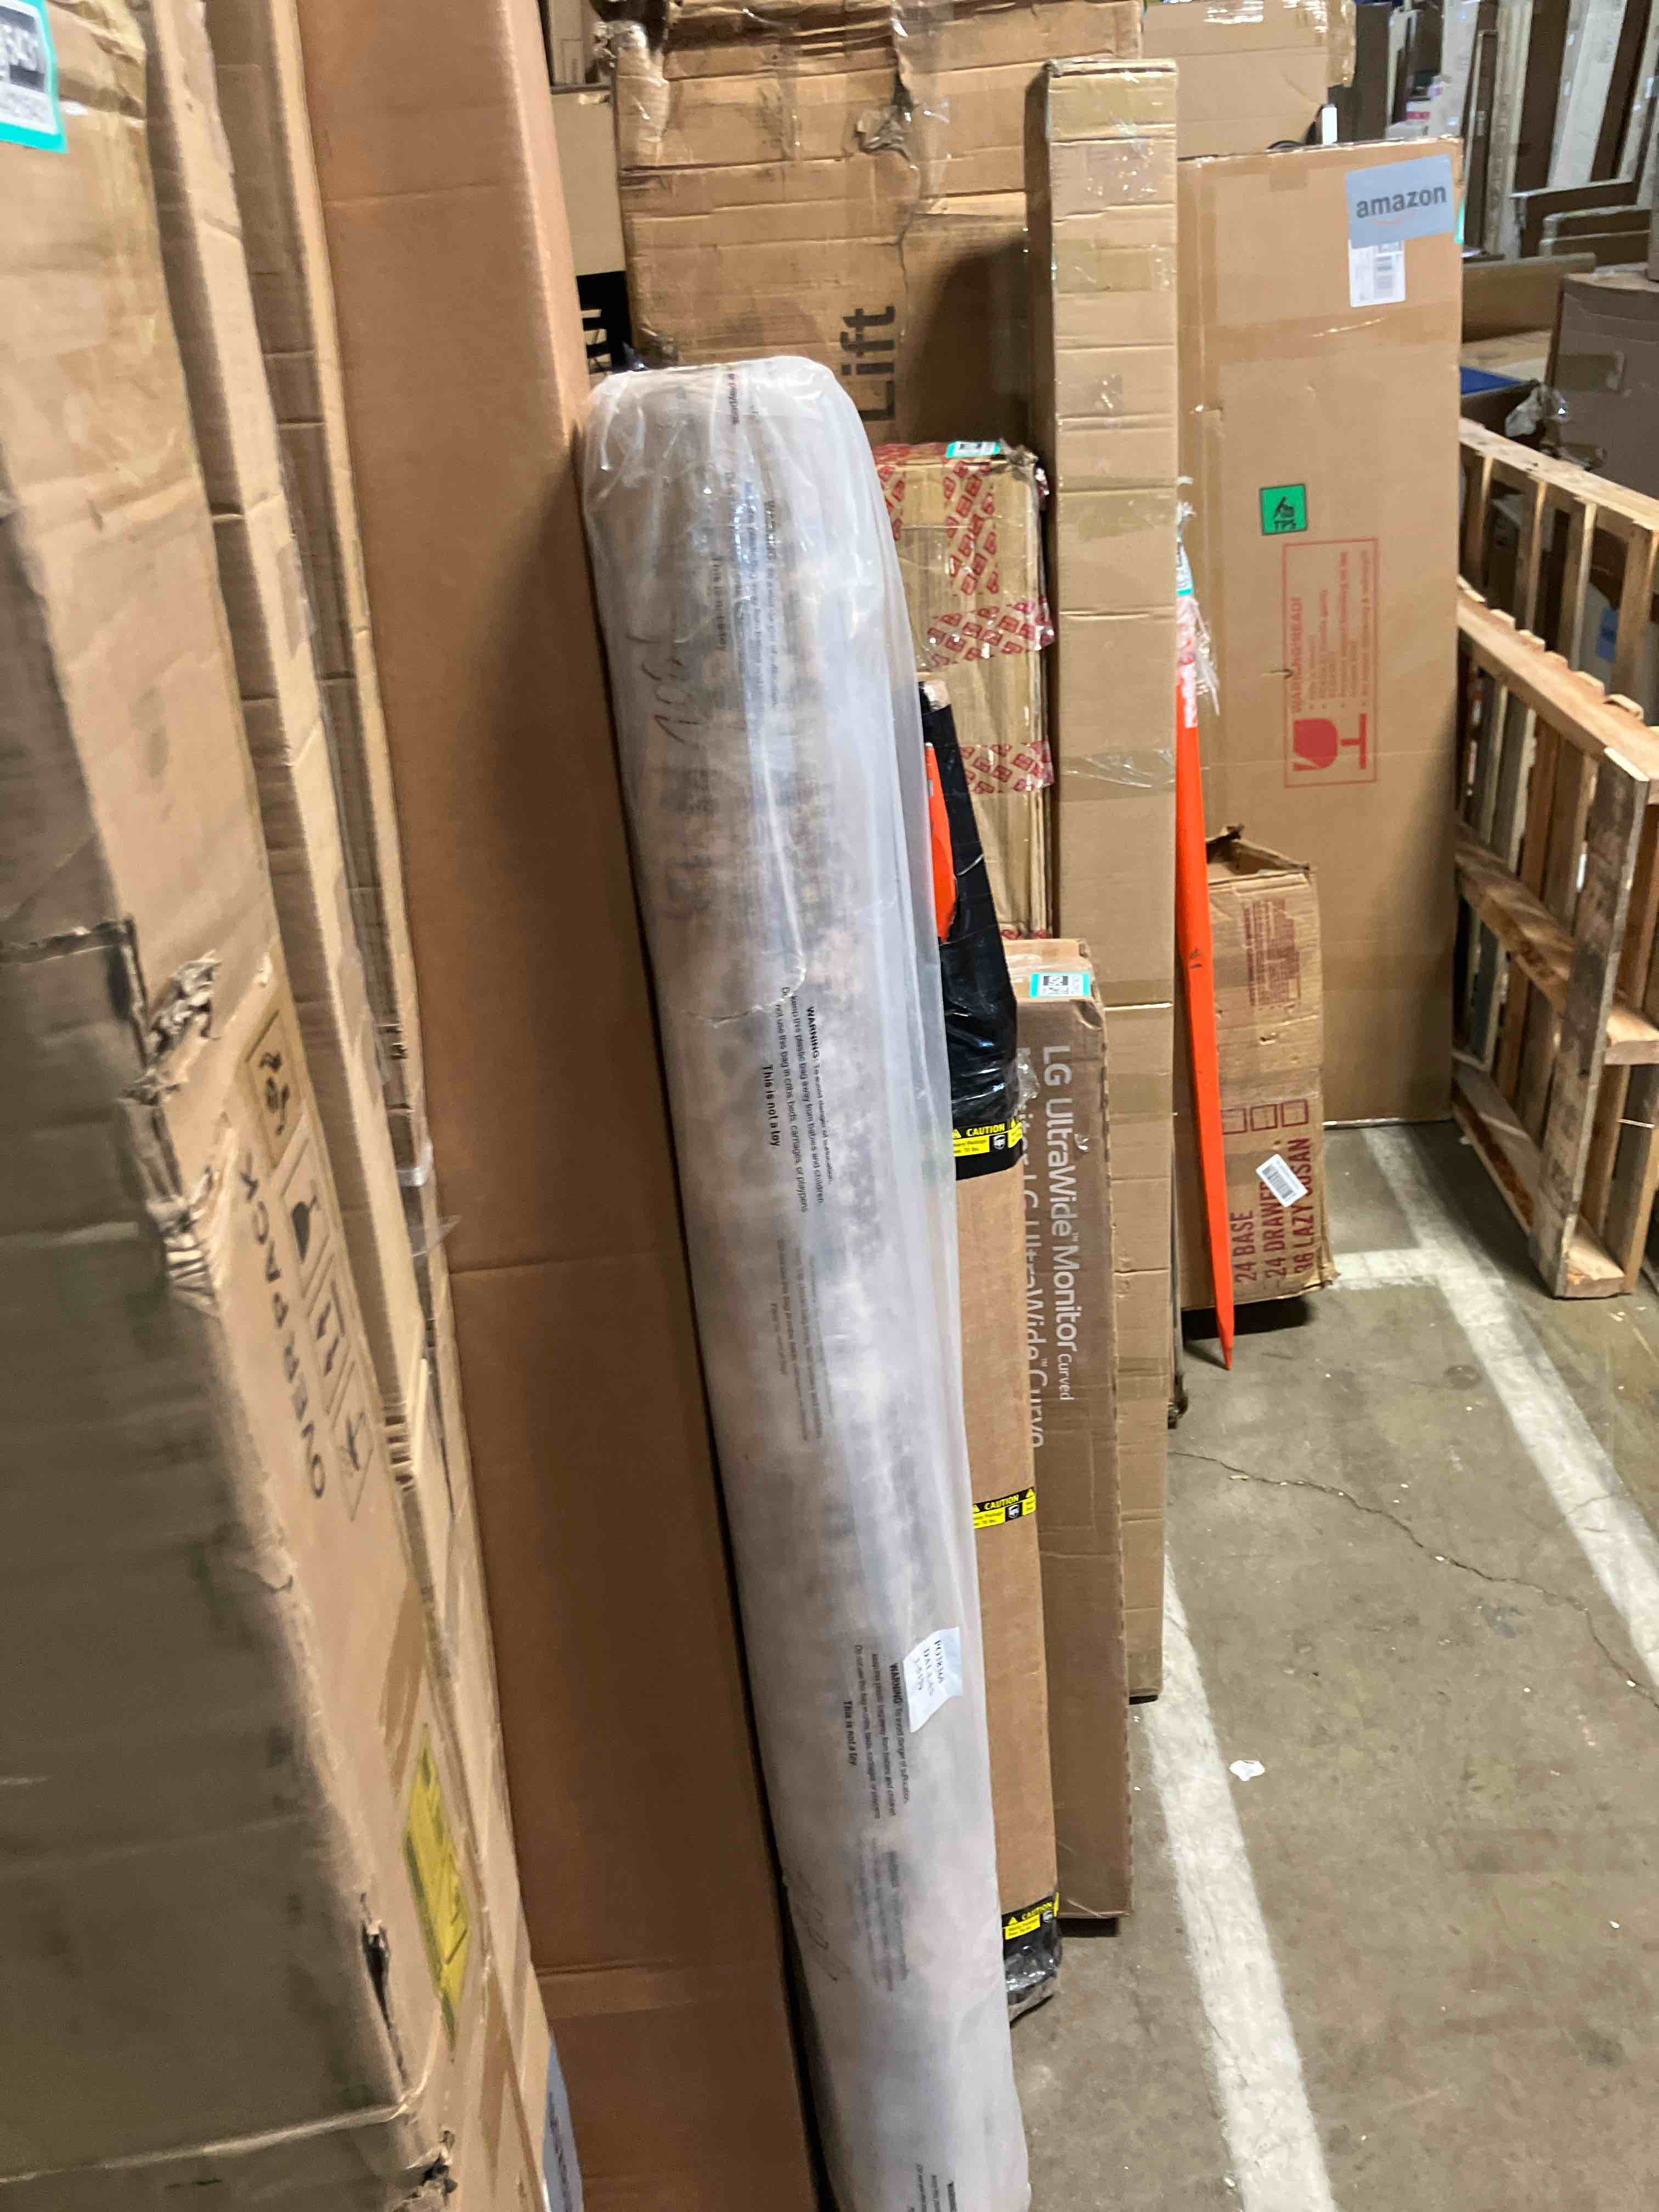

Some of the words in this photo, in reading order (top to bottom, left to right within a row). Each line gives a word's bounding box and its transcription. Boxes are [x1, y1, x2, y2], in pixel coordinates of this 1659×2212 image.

[1356, 185, 1447, 219] amazon
[840, 305, 895, 422] Lift
[775, 1004, 785, 1017] not
[777, 1019, 785, 1034] use
[778, 1034, 787, 1049] this
[780, 1051, 791, 1068] bag
[1043, 1045, 1073, 1087] LG
[761, 1064, 774, 1088] This
[764, 1089, 776, 1100] is
[767, 1102, 779, 1120] not
[770, 1130, 782, 1147] toy
[966, 1123, 1006, 1137] CAUTION
[812, 1153, 821, 1169] and
[1229, 1211, 1256, 1257] BASE
[1288, 1204, 1315, 1249] LAZY
[1233, 1261, 1257, 1283] 24
[1264, 1258, 1287, 1279] 24
[1052, 1245, 1082, 1352] Monitor
[1057, 1353, 1076, 1401] Curved
[984, 1493, 1019, 1511] CAUTION
[843, 1700, 854, 1719] This
[847, 1730, 857, 1745] not
